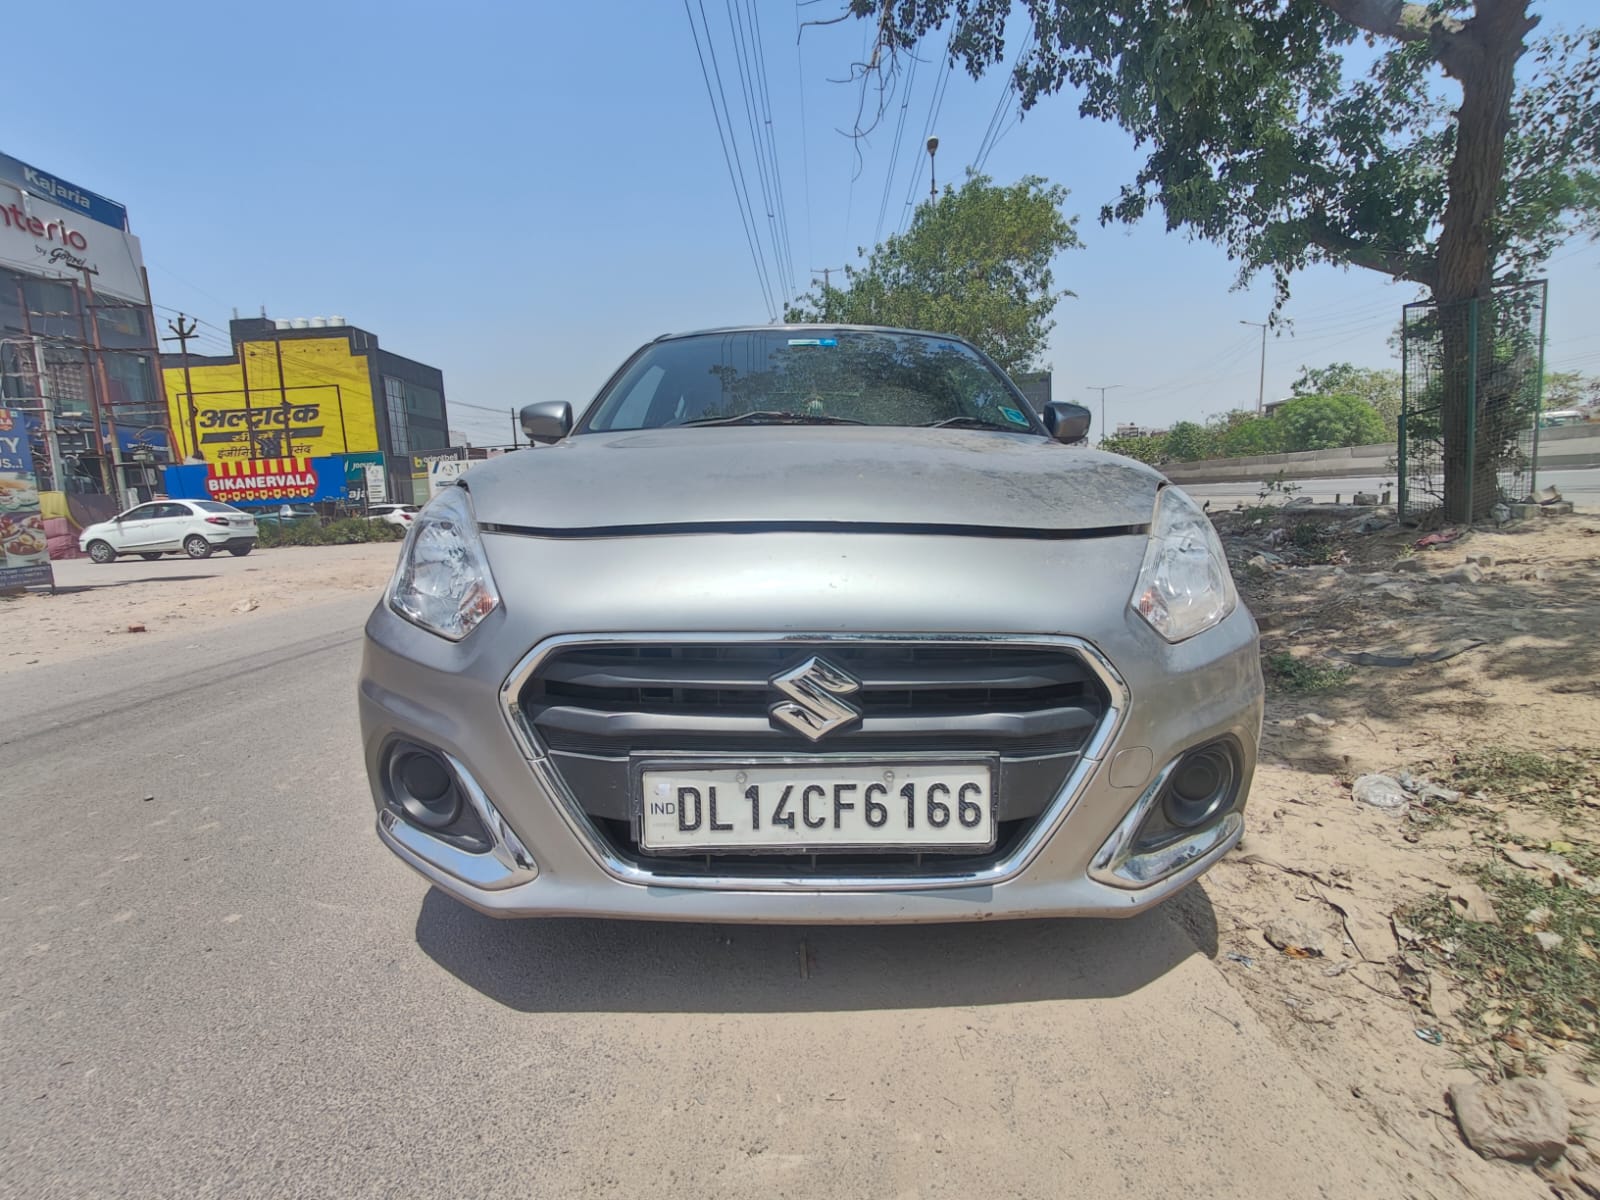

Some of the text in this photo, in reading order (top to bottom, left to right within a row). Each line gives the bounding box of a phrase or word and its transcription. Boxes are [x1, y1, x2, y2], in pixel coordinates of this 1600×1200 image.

[23, 167, 91, 209] Kajaria
[208, 473, 316, 491] BIKANERVALA
[650, 782, 983, 832] IND DL14CF6166
